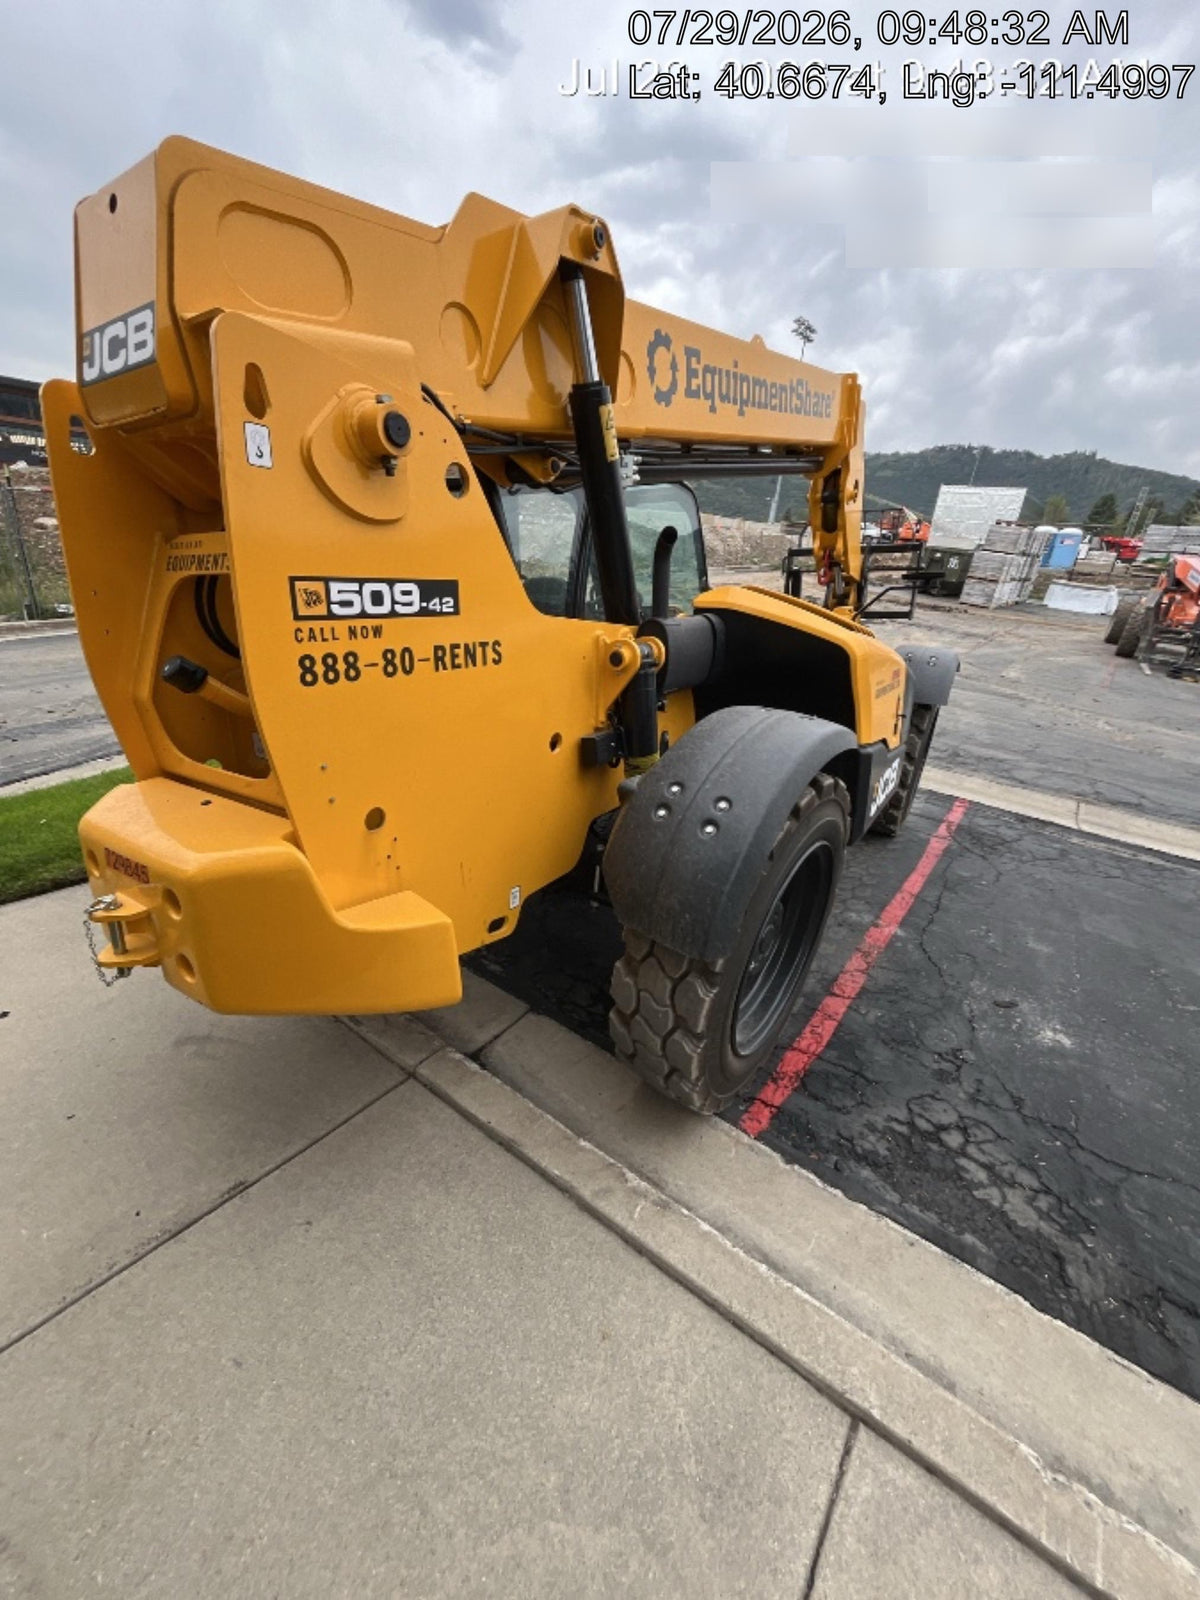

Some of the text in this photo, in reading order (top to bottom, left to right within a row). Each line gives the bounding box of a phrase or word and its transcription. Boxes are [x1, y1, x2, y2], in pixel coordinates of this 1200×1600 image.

[82, 308, 154, 382] JCB
[684, 345, 832, 417] EquipmentShare
[328, 581, 455, 616] 509-42
[294, 624, 384, 644] CALL NOW
[298, 639, 503, 688] 888-80-RENTS
